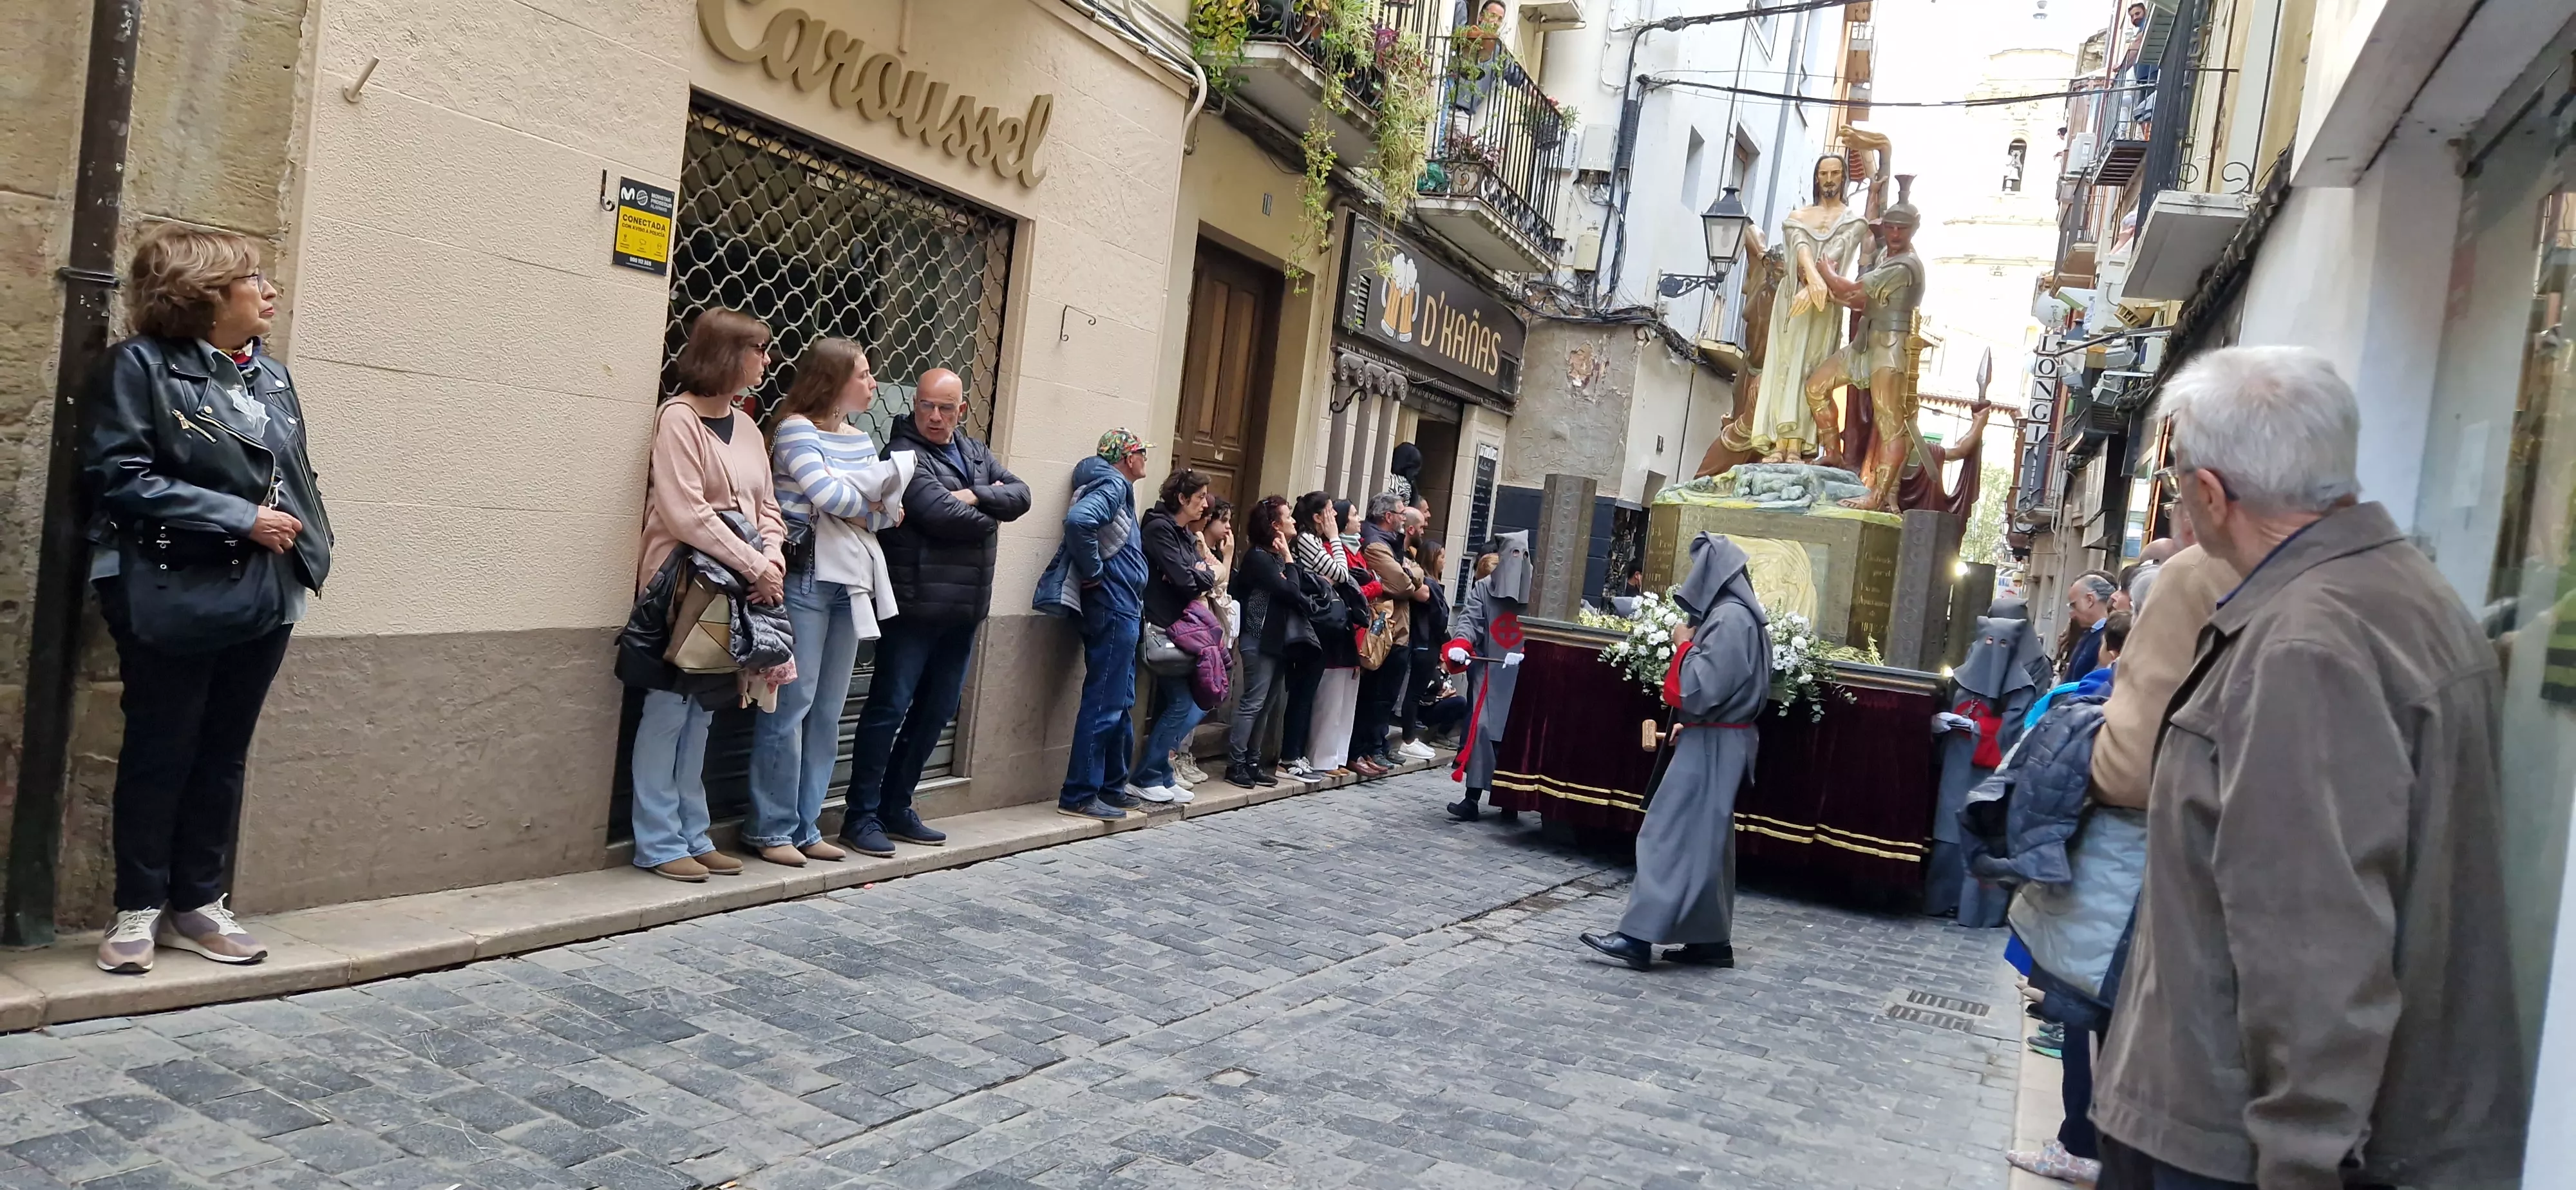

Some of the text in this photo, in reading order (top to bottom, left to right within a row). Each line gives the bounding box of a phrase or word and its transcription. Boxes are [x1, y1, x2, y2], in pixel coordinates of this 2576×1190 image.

[697, 0, 1054, 188] Caroussel
[622, 214, 666, 232] CONECTADA
[1421, 290, 1501, 376] D'KAÑAS
